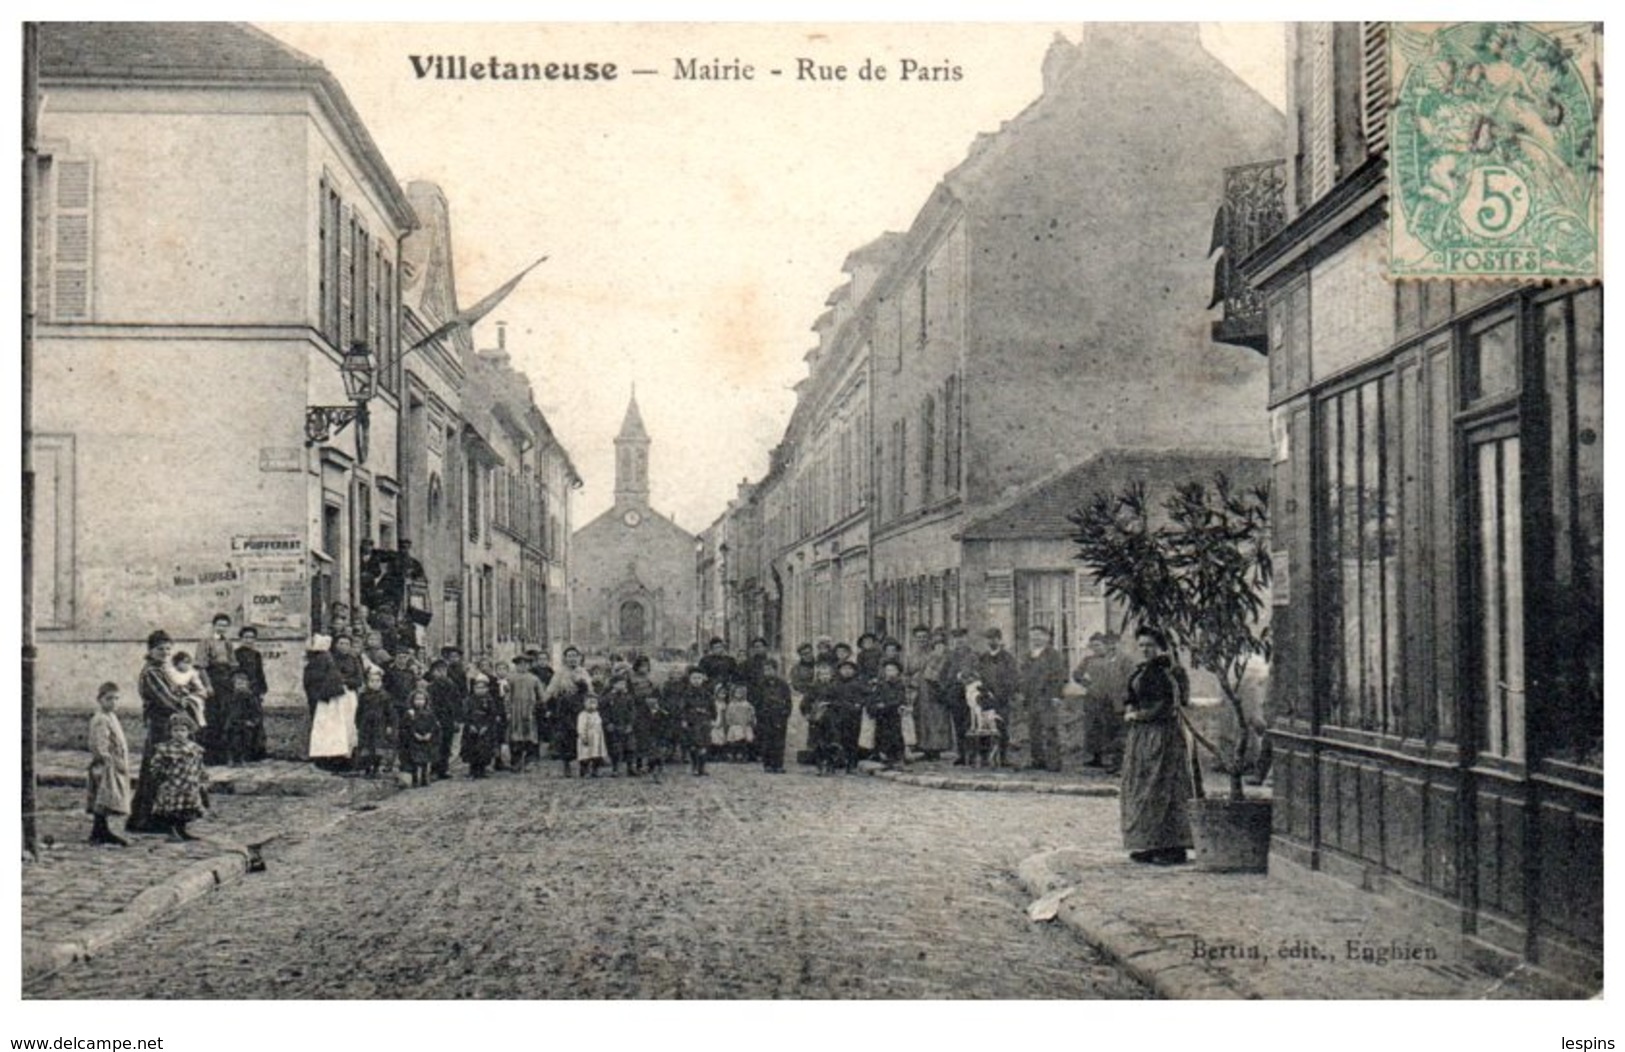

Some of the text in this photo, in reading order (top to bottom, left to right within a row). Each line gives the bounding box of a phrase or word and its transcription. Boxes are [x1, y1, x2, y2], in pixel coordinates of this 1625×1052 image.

[408, 55, 963, 82] Villetaneuse Mairie Rue de Paris
[1450, 251, 1537, 271] POSTES
[1193, 939, 1269, 965] Bertin,
[1345, 939, 1438, 966] Enghien
